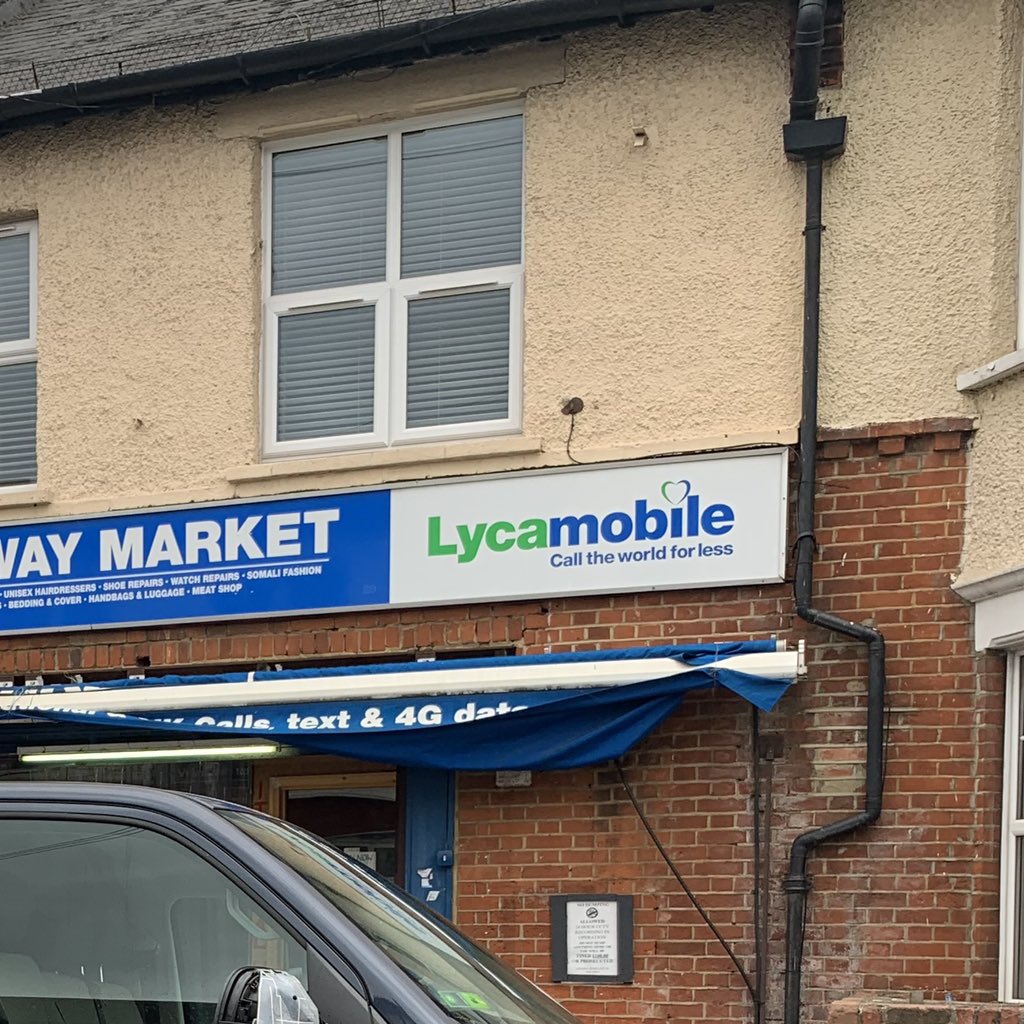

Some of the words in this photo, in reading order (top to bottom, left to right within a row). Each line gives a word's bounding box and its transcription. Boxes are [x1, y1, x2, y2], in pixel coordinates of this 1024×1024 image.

[99, 508, 340, 571] MARKET
[428, 494, 735, 564] Lycamobile
[550, 552, 582, 567] Call
[586, 550, 615, 566] the
[617, 547, 667, 563] world
[670, 545, 696, 560] for
[698, 543, 734, 557] less
[3, 588, 34, 599] UNISEX
[35, 583, 97, 597] HAIRDRESSERS
[103, 580, 126, 591] SHOE
[128, 577, 164, 589] REPAIRS
[170, 574, 201, 586] WATCH
[203, 571, 240, 583] REPAIRS
[246, 568, 281, 580] SOMALI
[283, 565, 323, 577] FASHION
[8, 597, 45, 610] BEDDING
[46, 597, 52, 607] &
[54, 595, 82, 606] COVER
[88, 590, 134, 603] HANDBAGS
[136, 590, 142, 600] &
[144, 587, 185, 600] LUGGAGE
[192, 585, 216, 596] MEAT
[218, 583, 243, 594] SHOP
[287, 710, 351, 730] text
[360, 707, 384, 729] &
[395, 704, 443, 726] 4G
[454, 702, 529, 723] dat
